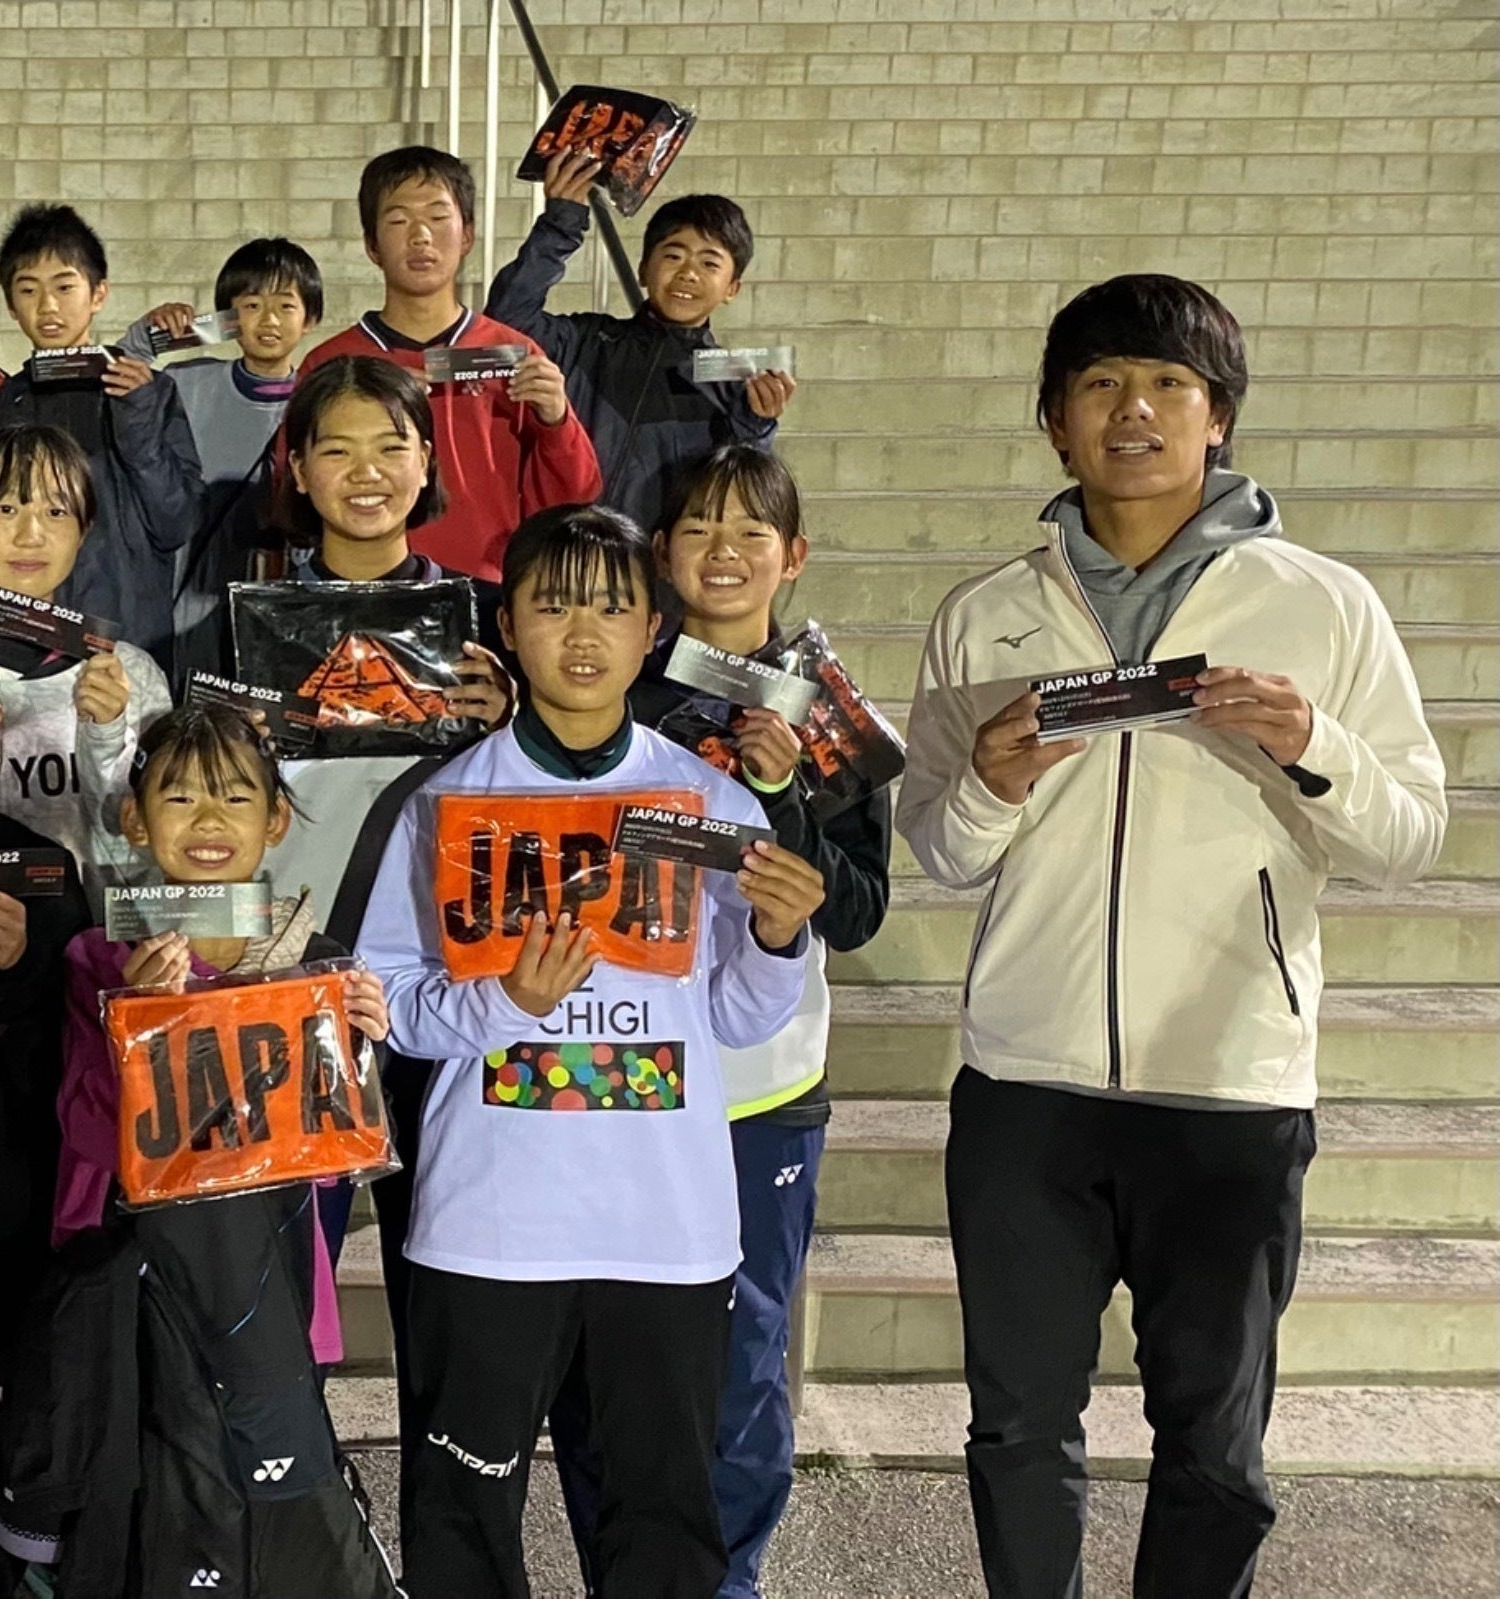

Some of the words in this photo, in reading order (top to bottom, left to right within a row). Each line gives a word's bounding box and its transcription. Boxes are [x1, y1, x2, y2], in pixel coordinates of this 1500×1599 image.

[33, 599, 50, 612] GP
[52, 605, 84, 625] 2022
[684, 640, 726, 661] JAPAN
[727, 654, 745, 667] GP
[746, 661, 780, 680] 2022
[193, 671, 230, 690] JAPAN
[231, 681, 248, 694] GP
[249, 686, 282, 703] 2022
[1036, 675, 1088, 694] JAPAN
[1091, 671, 1113, 684] GP
[1117, 664, 1158, 681] 2022
[627, 807, 675, 824] JAPAN
[677, 815, 698, 828] GP
[700, 819, 738, 837] 2022
[112, 887, 161, 901] JAPAN
[165, 886, 184, 899] GP
[188, 885, 225, 898] 2022
